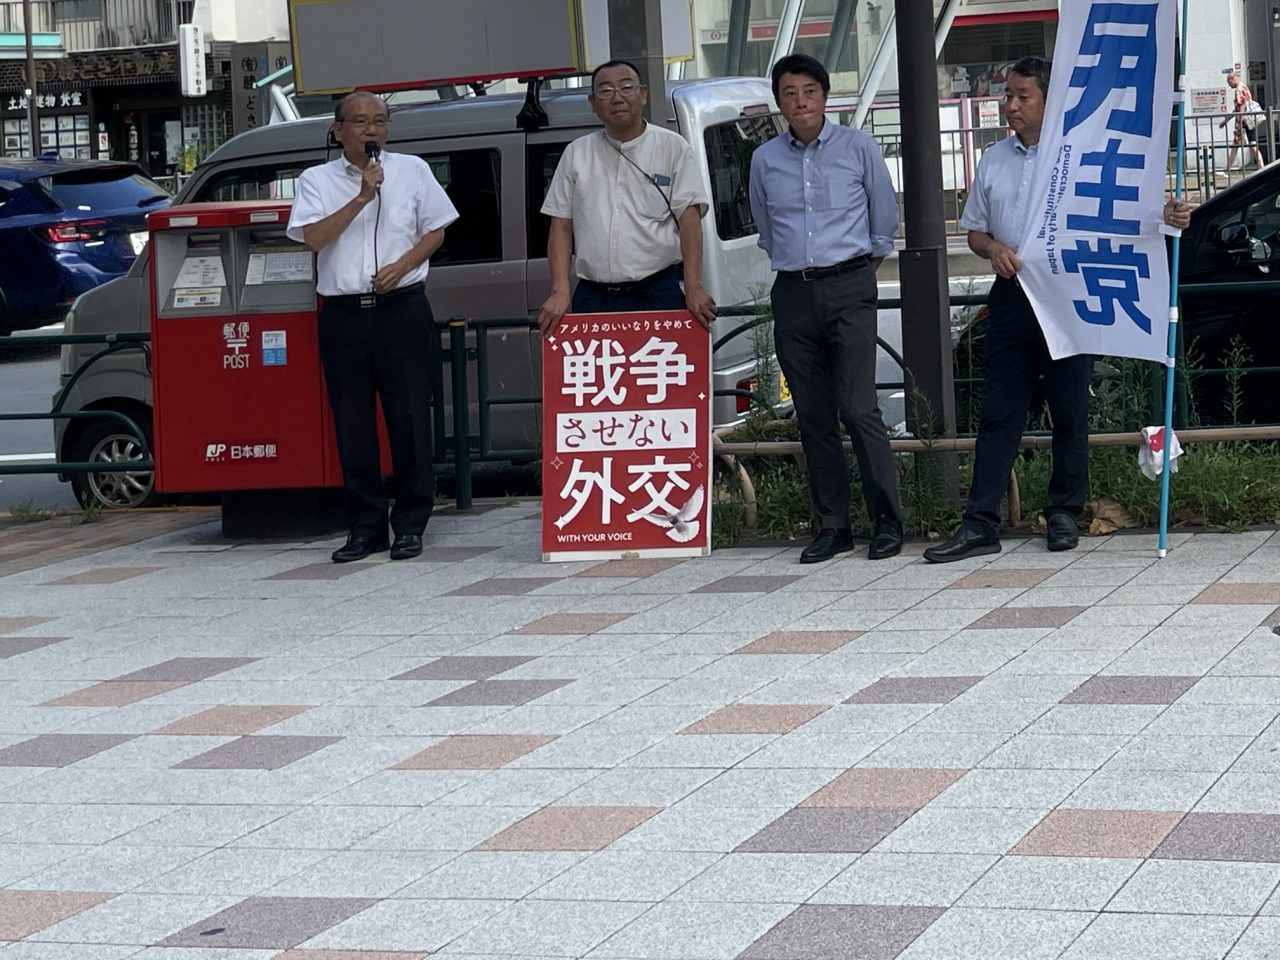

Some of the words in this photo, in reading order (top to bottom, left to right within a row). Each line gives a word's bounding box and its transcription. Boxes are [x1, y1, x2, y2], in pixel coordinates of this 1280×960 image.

[223, 322, 250, 339] 郵便
[560, 319, 693, 334] アメリカのいいなりをやめて
[223, 354, 250, 369] POST
[561, 336, 694, 407] 戦争
[563, 414, 689, 447] させない
[231, 444, 278, 459] 日本郵便
[557, 456, 692, 525] 外交
[557, 534, 581, 543] WITH
[582, 533, 606, 542] YOUR
[607, 532, 633, 541] VOICE
